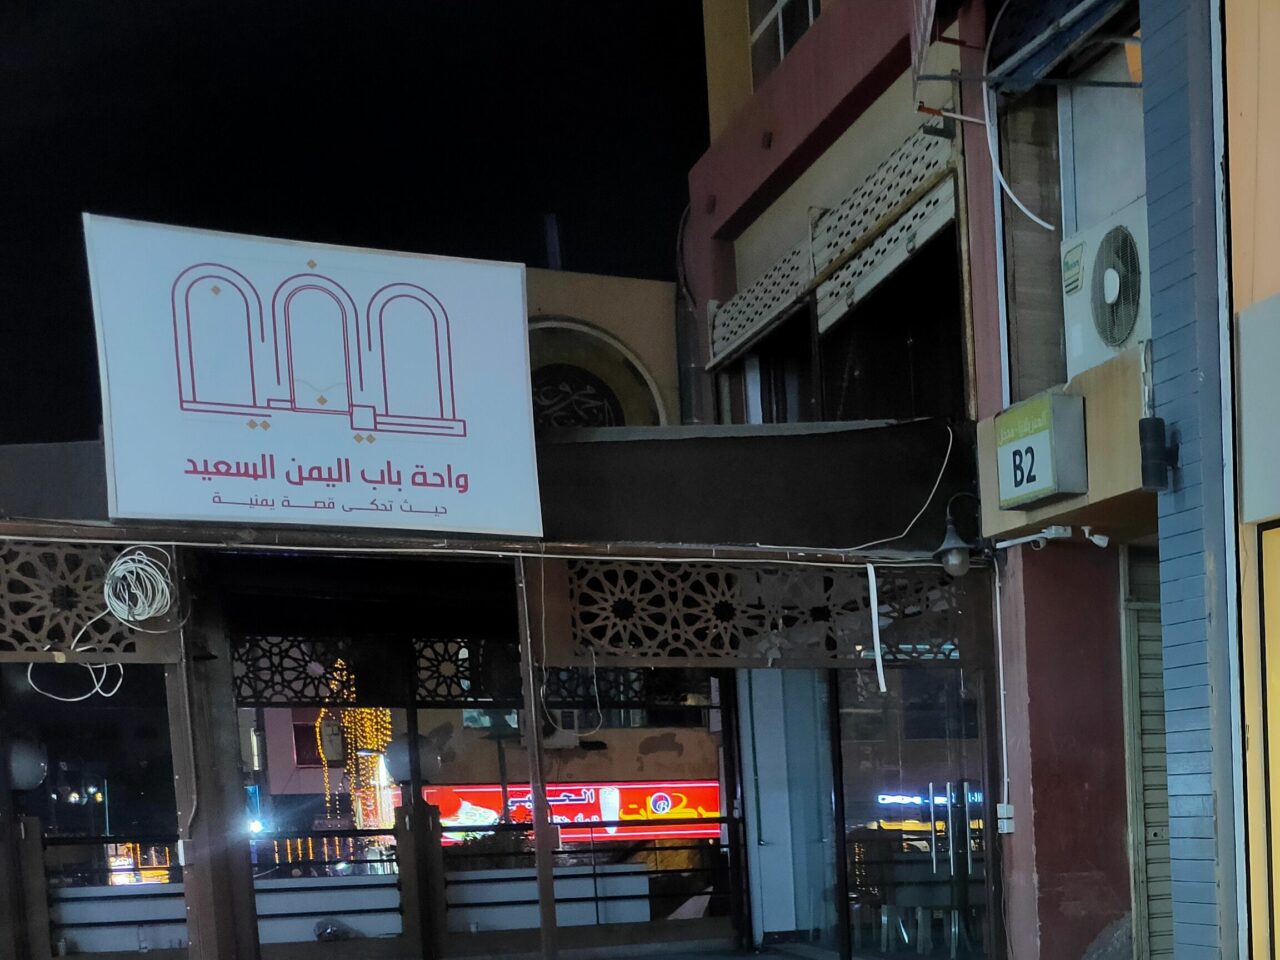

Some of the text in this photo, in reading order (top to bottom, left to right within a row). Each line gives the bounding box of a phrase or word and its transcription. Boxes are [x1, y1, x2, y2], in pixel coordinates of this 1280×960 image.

[183, 453, 470, 494] واحة باب اليمن السعيد
[1012, 446, 1037, 488] B2
